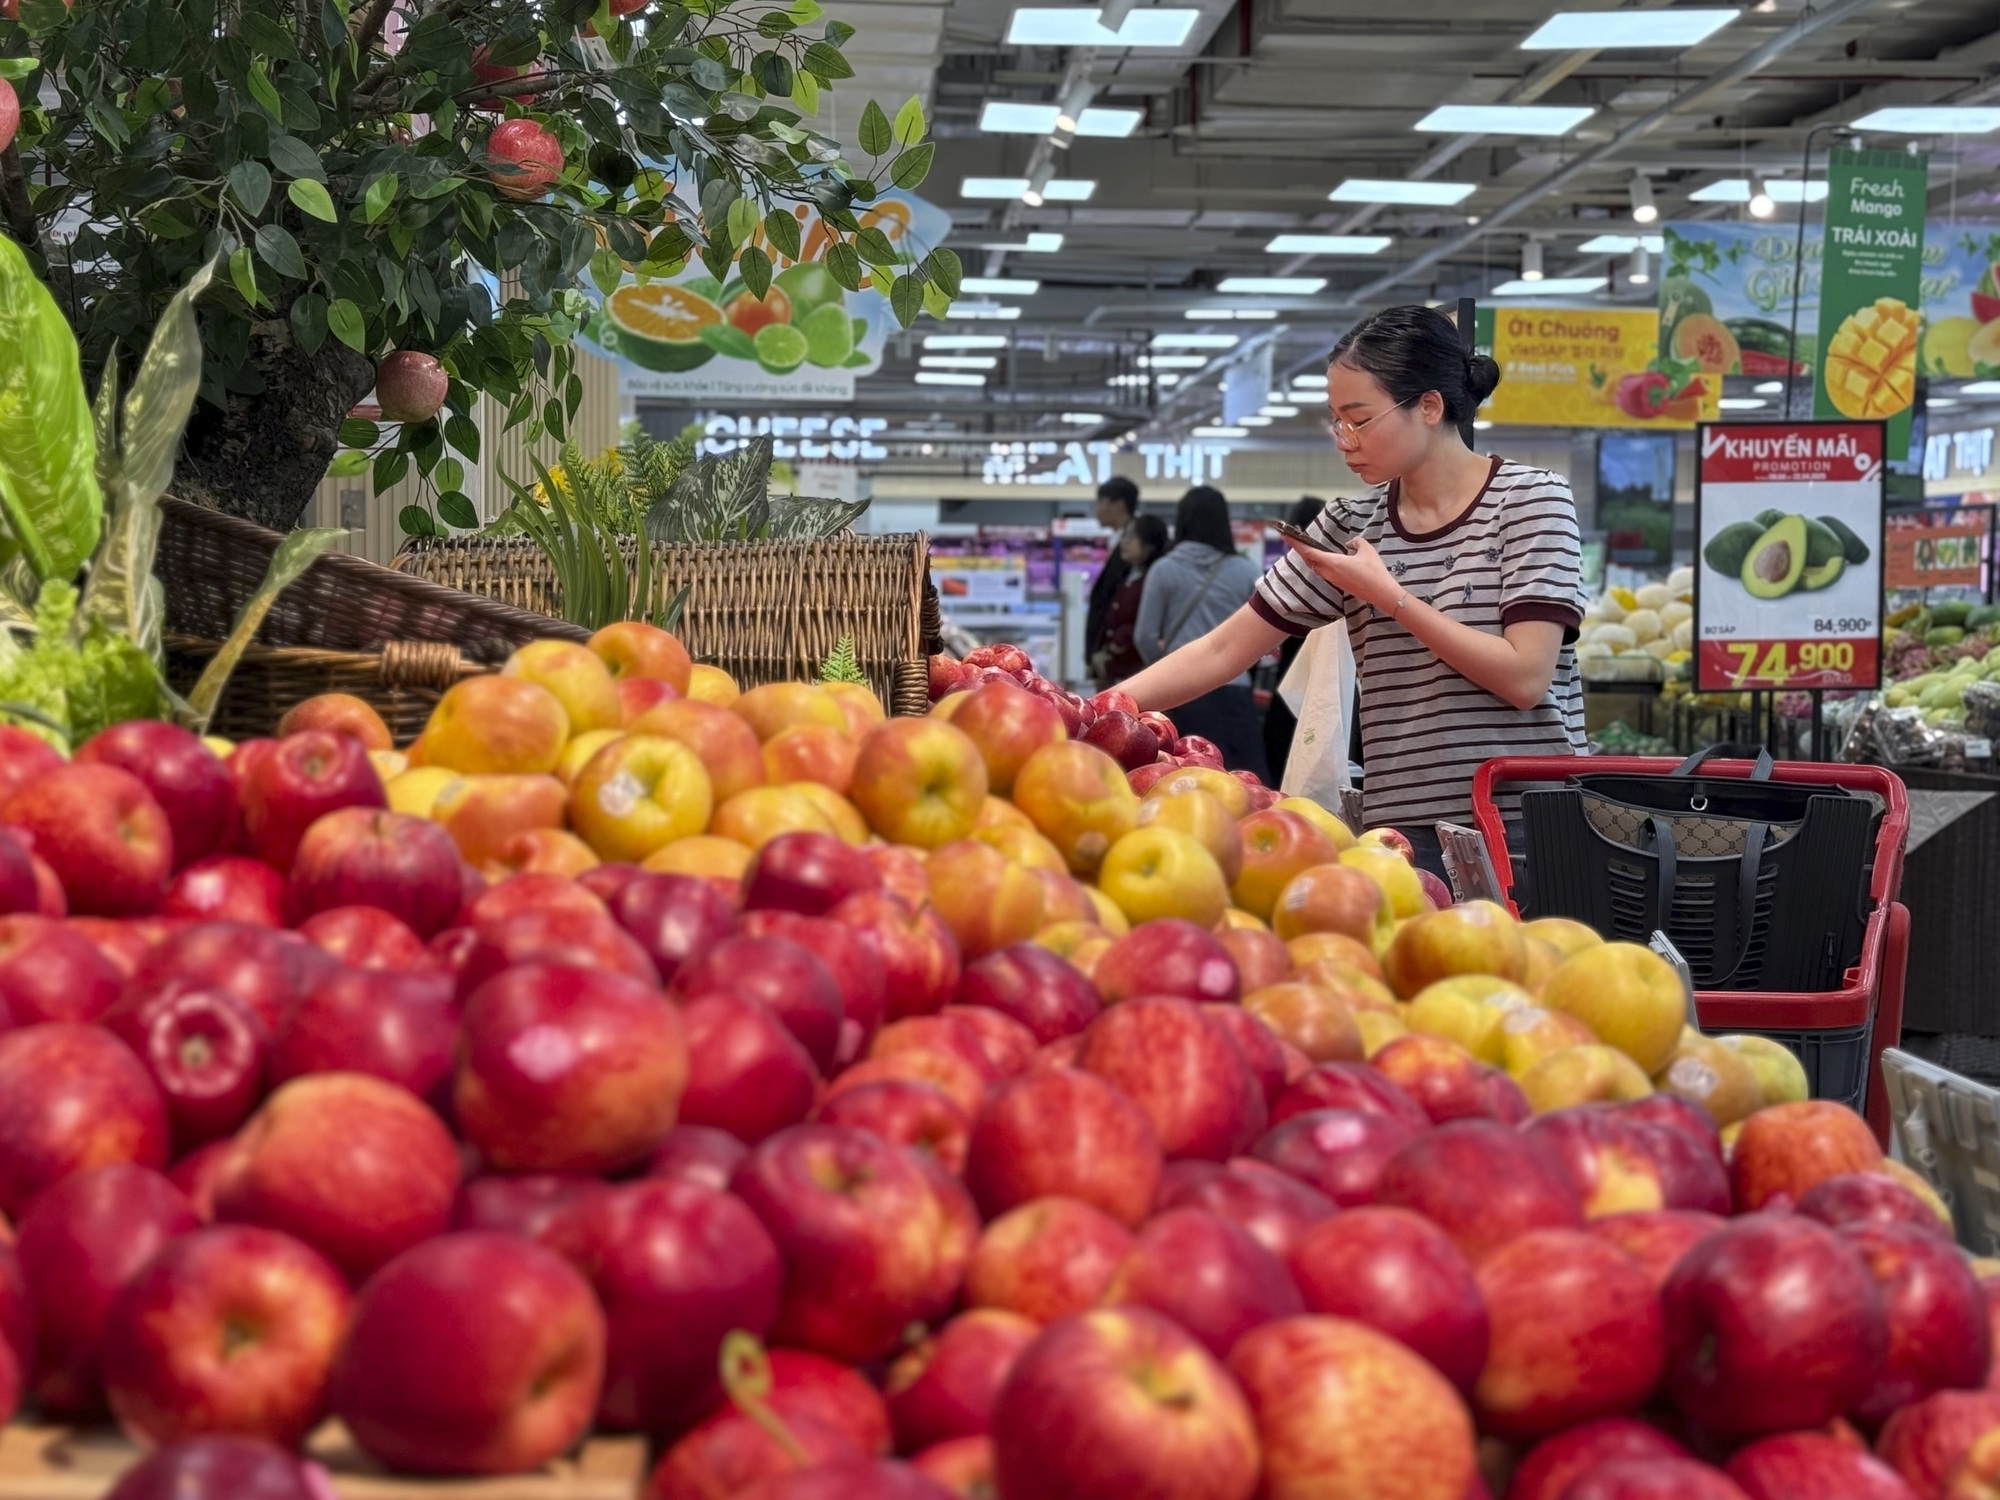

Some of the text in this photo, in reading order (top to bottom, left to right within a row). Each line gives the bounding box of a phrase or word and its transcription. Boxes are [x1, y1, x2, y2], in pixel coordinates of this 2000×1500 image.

[1850, 177, 1904, 198] Fresh
[1850, 198, 1903, 219] Mango
[1831, 224, 1917, 248] TRÁI XOÀI
[704, 414, 887, 459] CHEESE
[1724, 433, 1856, 459] KHUYẾN MÃI
[982, 441, 1231, 486] MEAT THỊT
[1753, 461, 1831, 472] PROMOTION
[1727, 642, 1854, 688] 74,900
